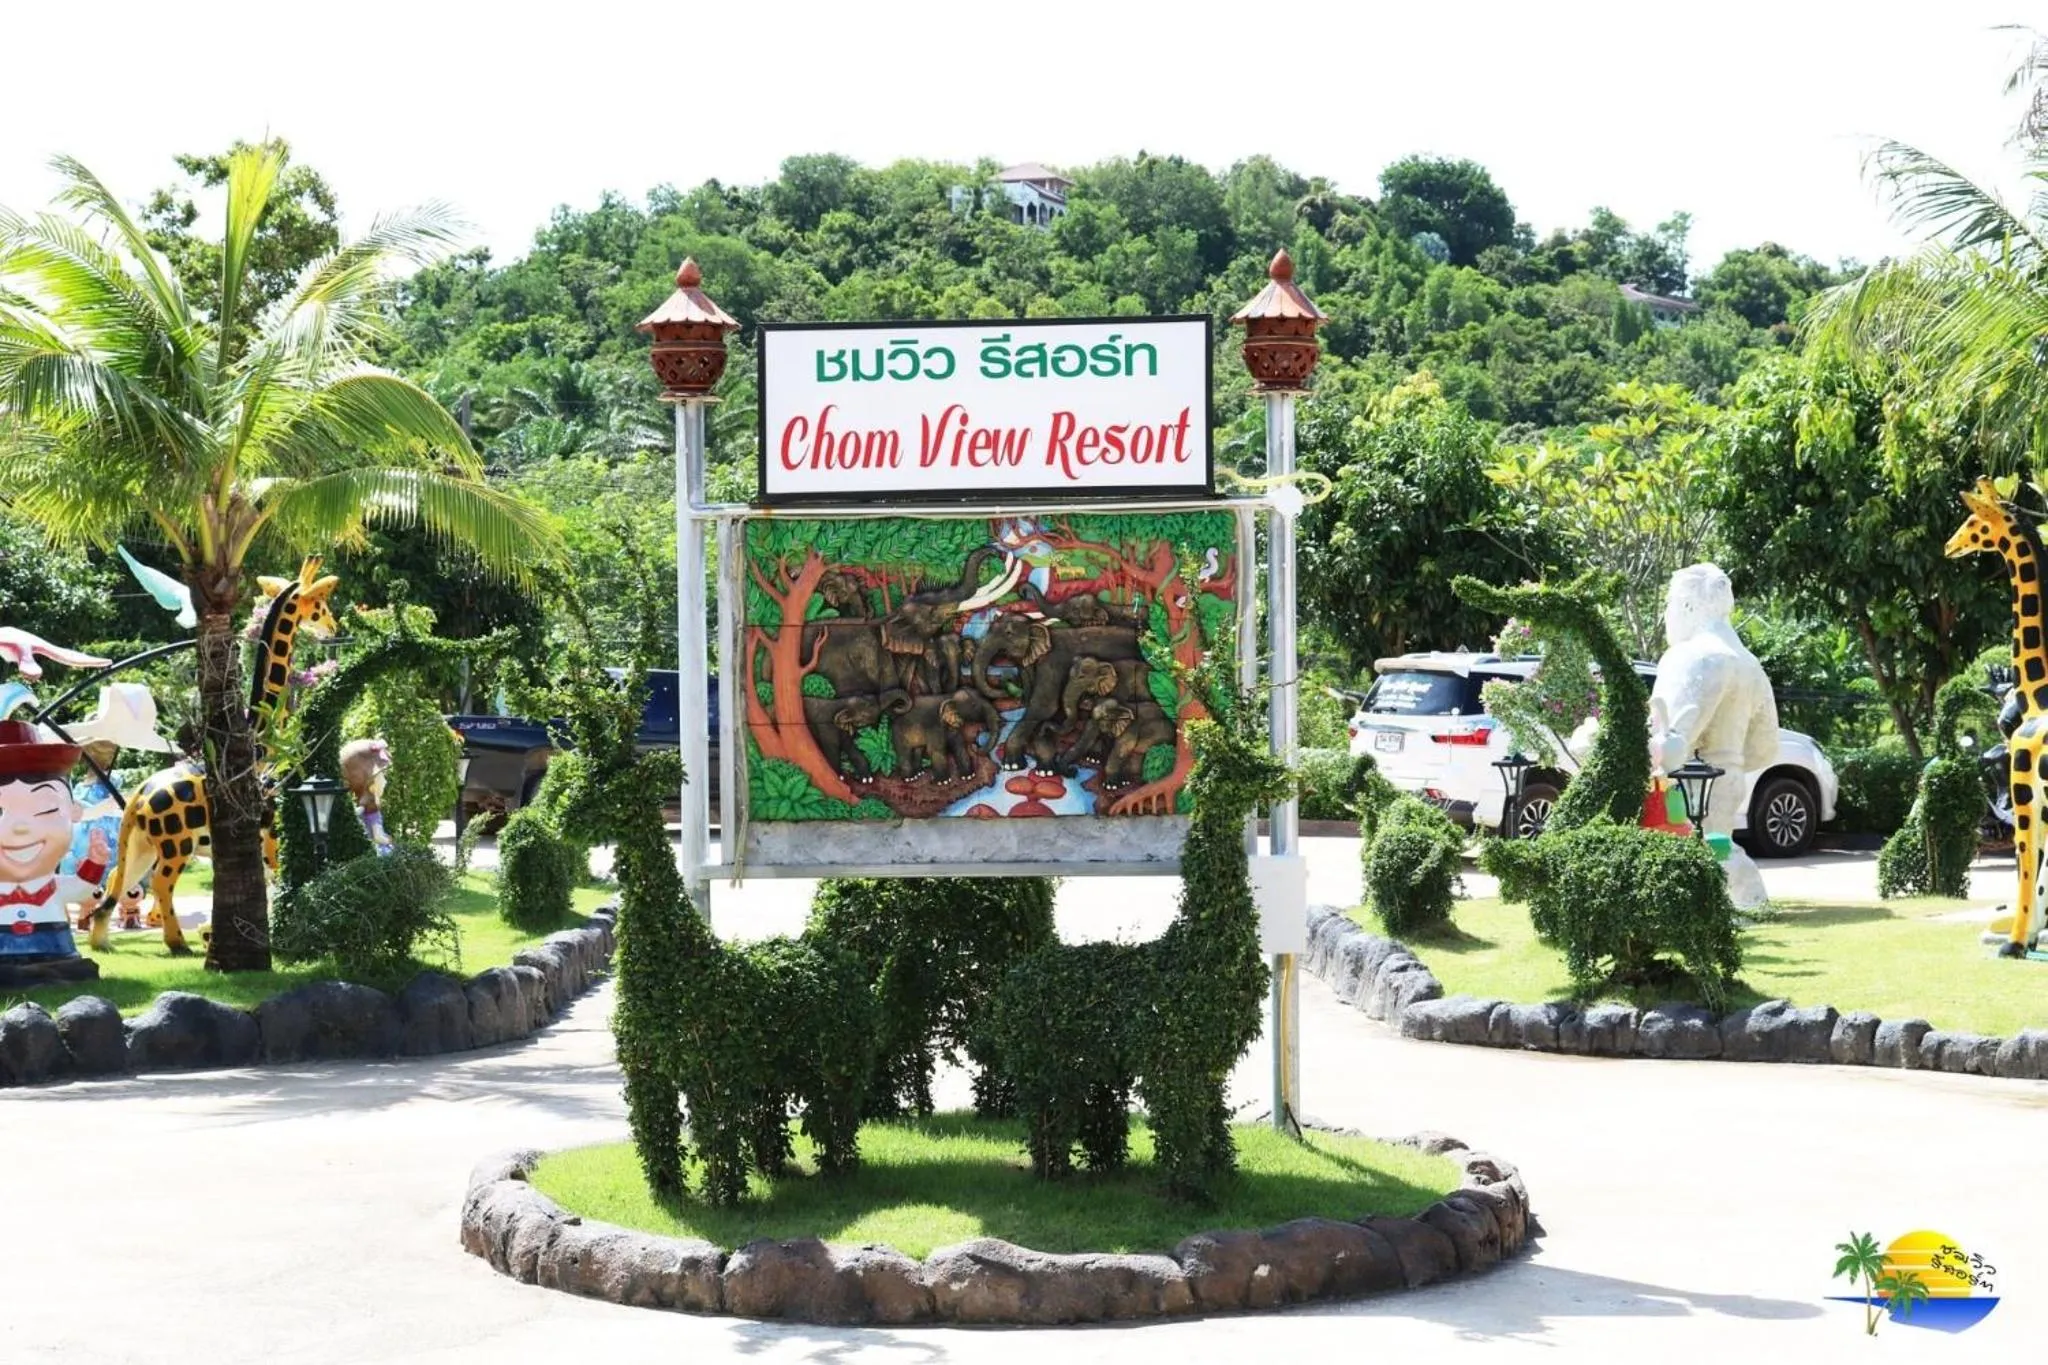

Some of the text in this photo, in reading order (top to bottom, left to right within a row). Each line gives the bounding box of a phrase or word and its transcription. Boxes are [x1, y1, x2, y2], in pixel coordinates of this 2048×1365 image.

[815, 333, 1159, 384] ชมวิว รีสอร์ท
[780, 403, 1193, 481] Chom View Resort
